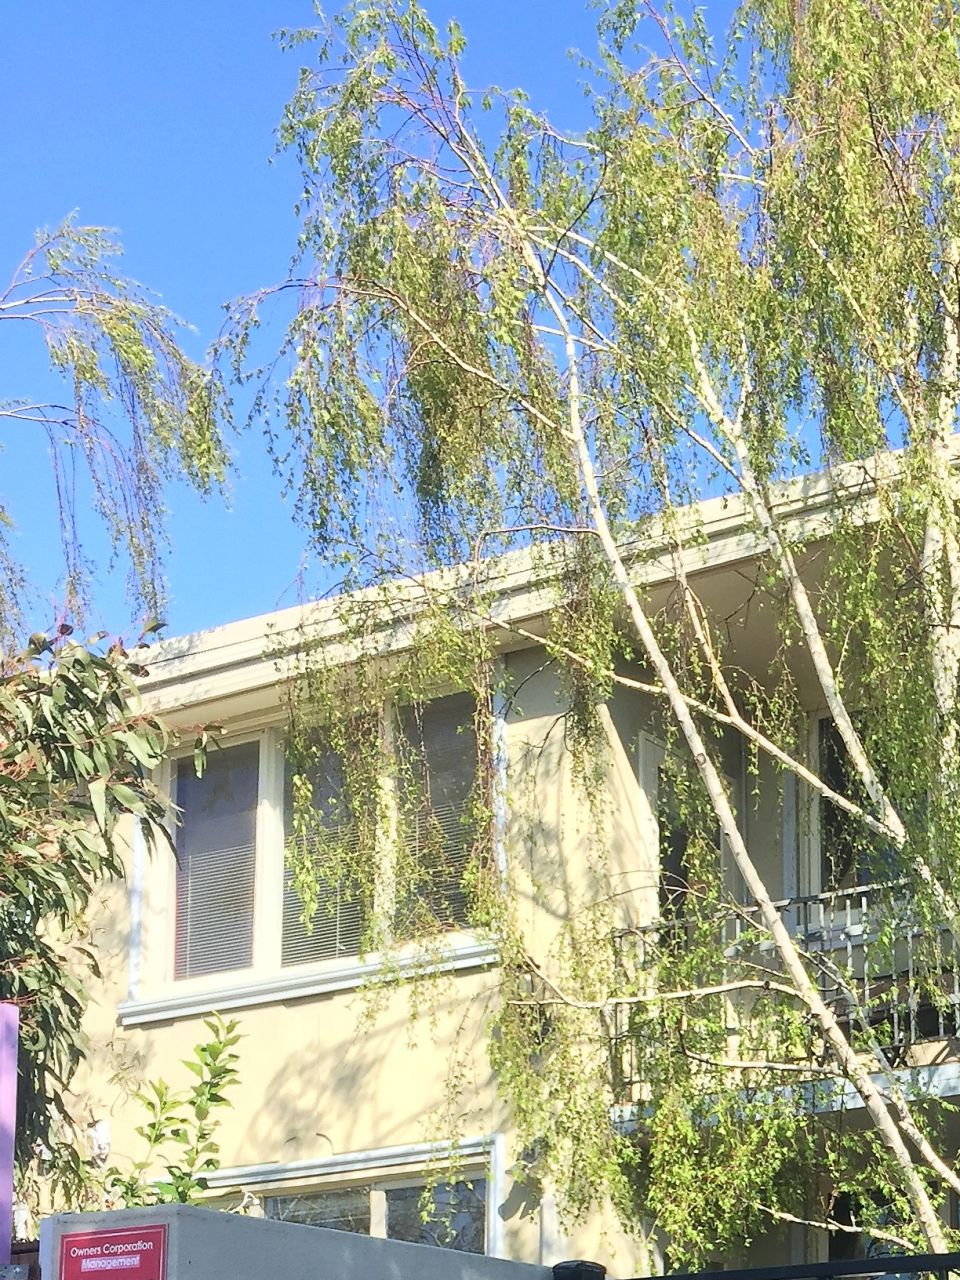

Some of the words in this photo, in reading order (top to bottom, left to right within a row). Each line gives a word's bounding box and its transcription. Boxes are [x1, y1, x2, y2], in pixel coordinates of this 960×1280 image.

[70, 1247, 101, 1258] Owners
[103, 1240, 153, 1254] Corporation
[82, 1257, 140, 1269] Management
